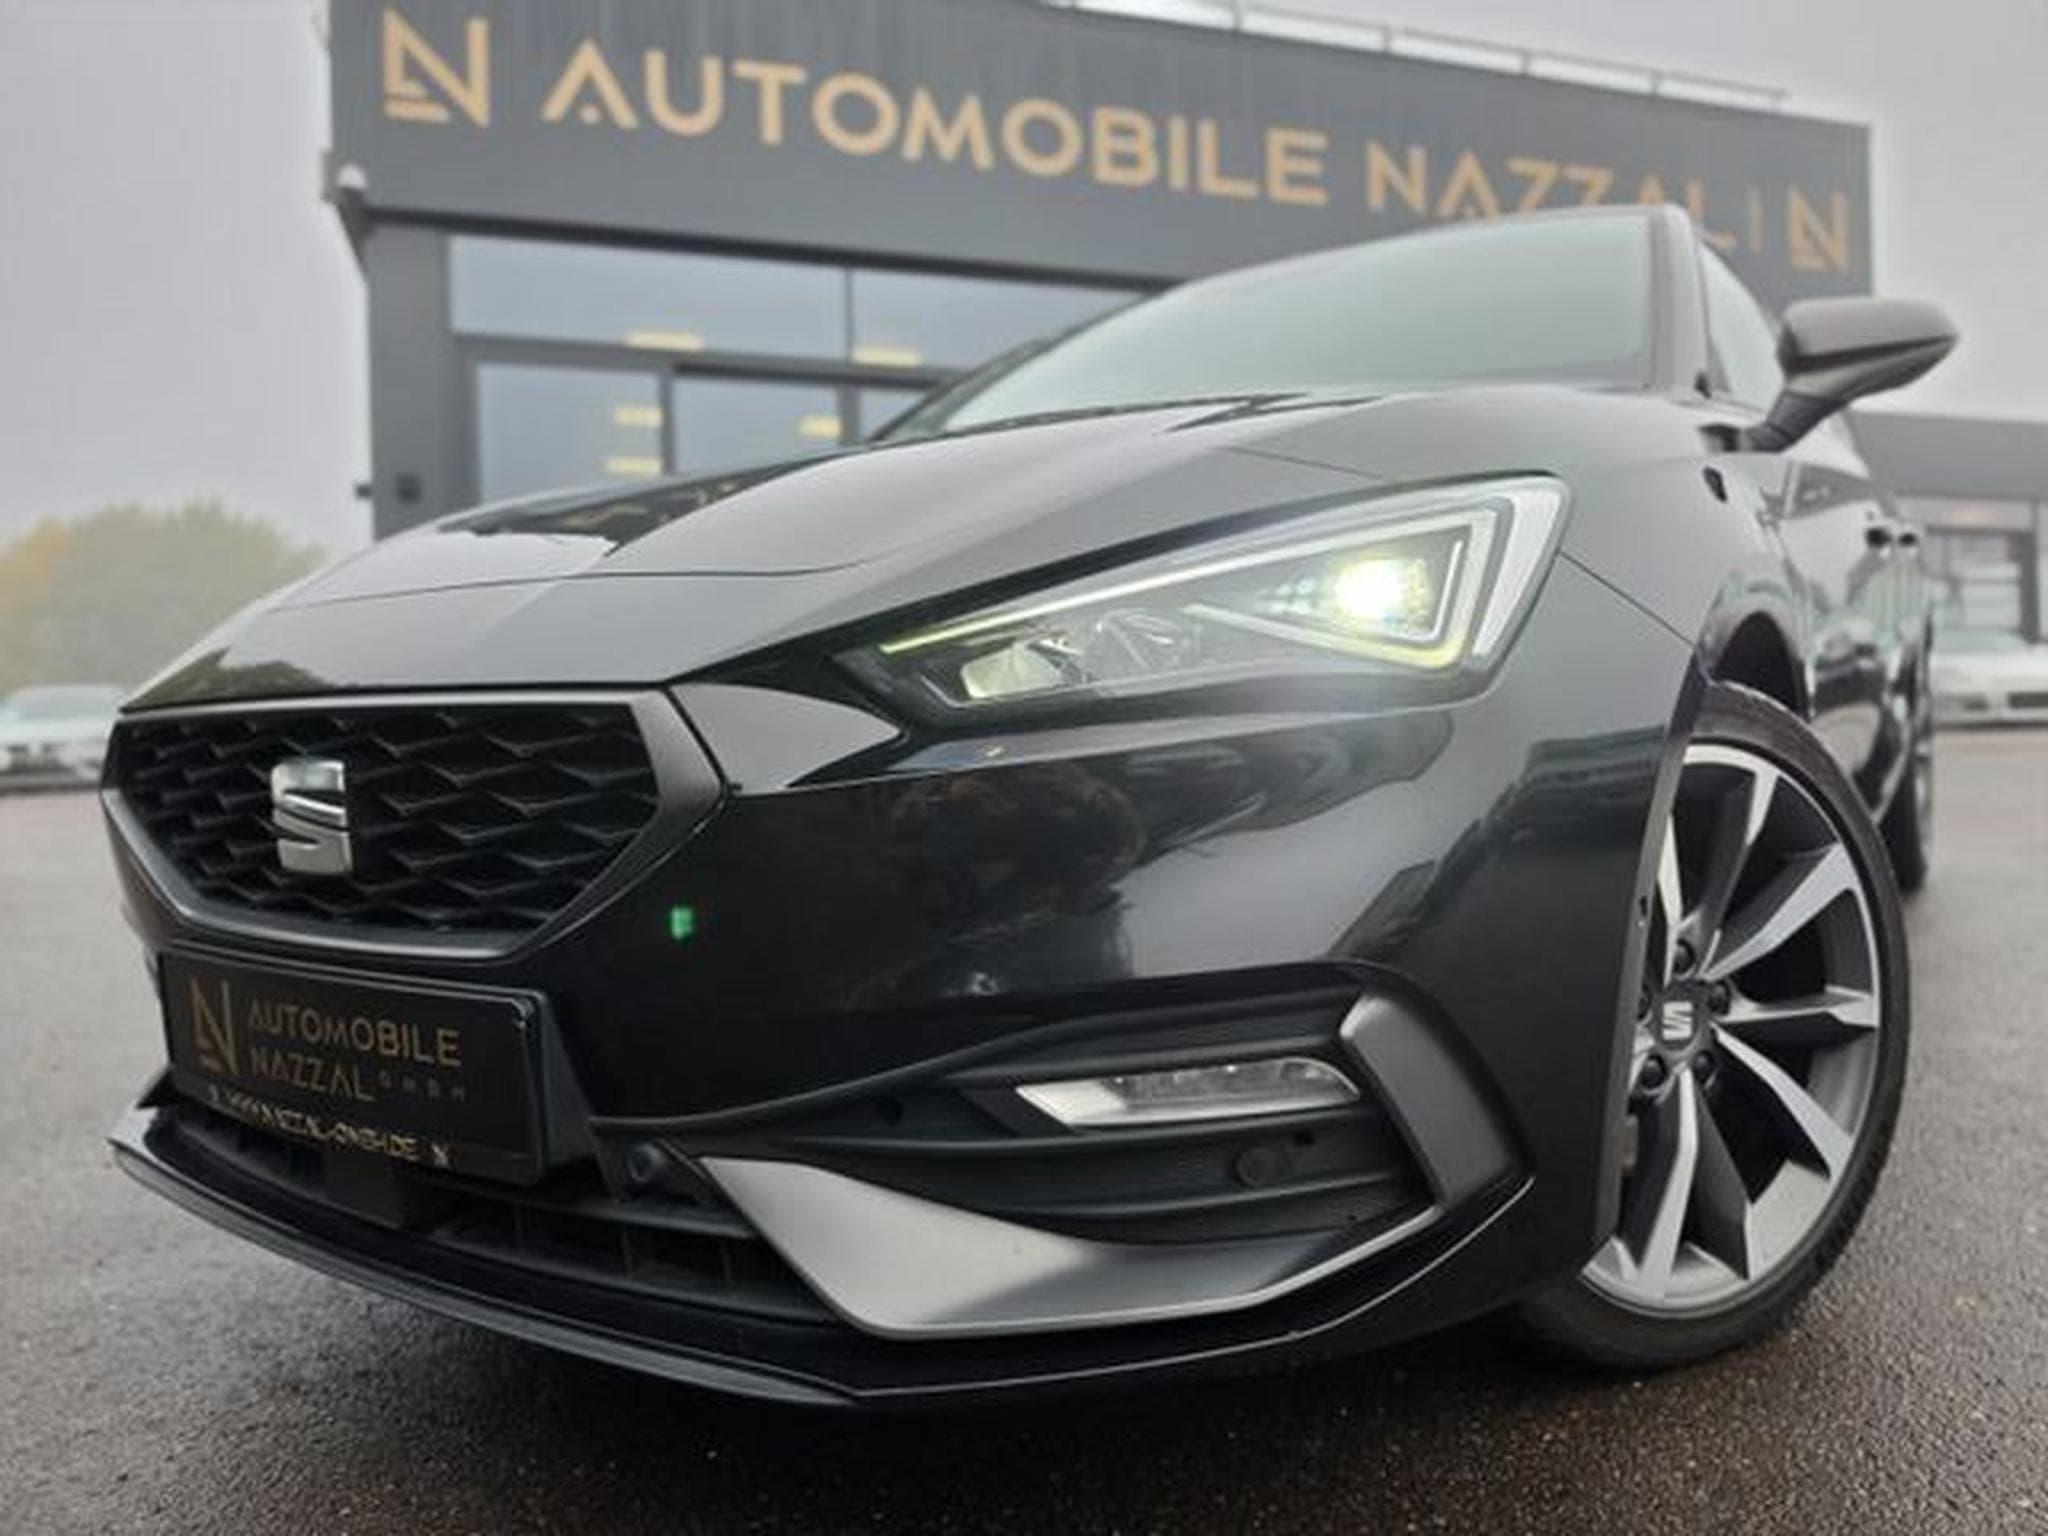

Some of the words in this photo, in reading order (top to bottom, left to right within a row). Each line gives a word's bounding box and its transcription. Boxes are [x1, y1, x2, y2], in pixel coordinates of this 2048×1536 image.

[541, 39, 1328, 204] AUTOMOBILE
[249, 1000, 461, 1067] AUTOMOBILE
[251, 1047, 376, 1102] NAZZAL
